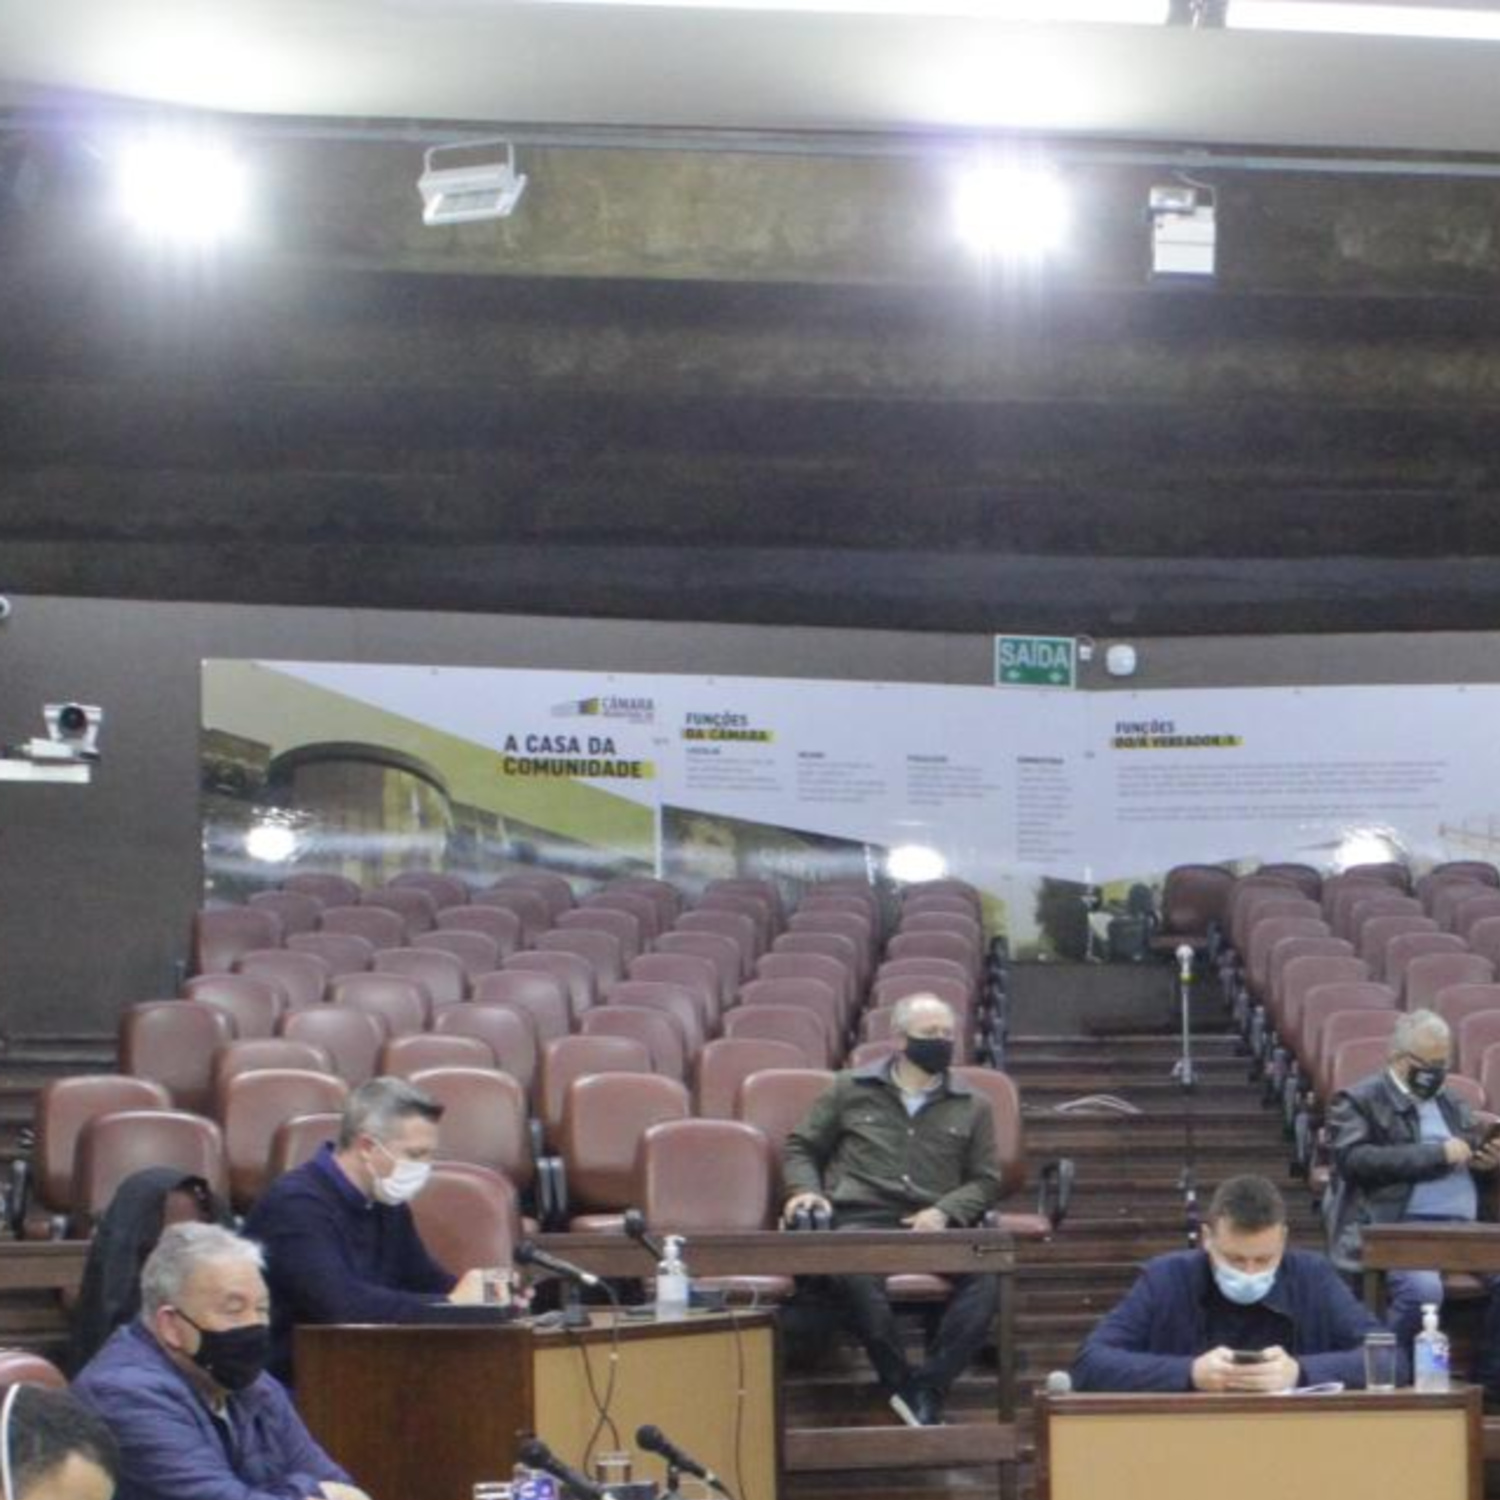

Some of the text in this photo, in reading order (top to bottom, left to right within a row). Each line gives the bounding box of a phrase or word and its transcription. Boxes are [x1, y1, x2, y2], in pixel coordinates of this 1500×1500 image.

[1000, 639, 1068, 668] SAÍDA
[686, 710, 748, 727] FUNÇÕES
[1115, 719, 1175, 735] FUNÇÕES
[708, 727, 769, 742] CÂMARA
[505, 735, 617, 756] A CASA DA
[503, 757, 643, 779] COMUNIDADE
